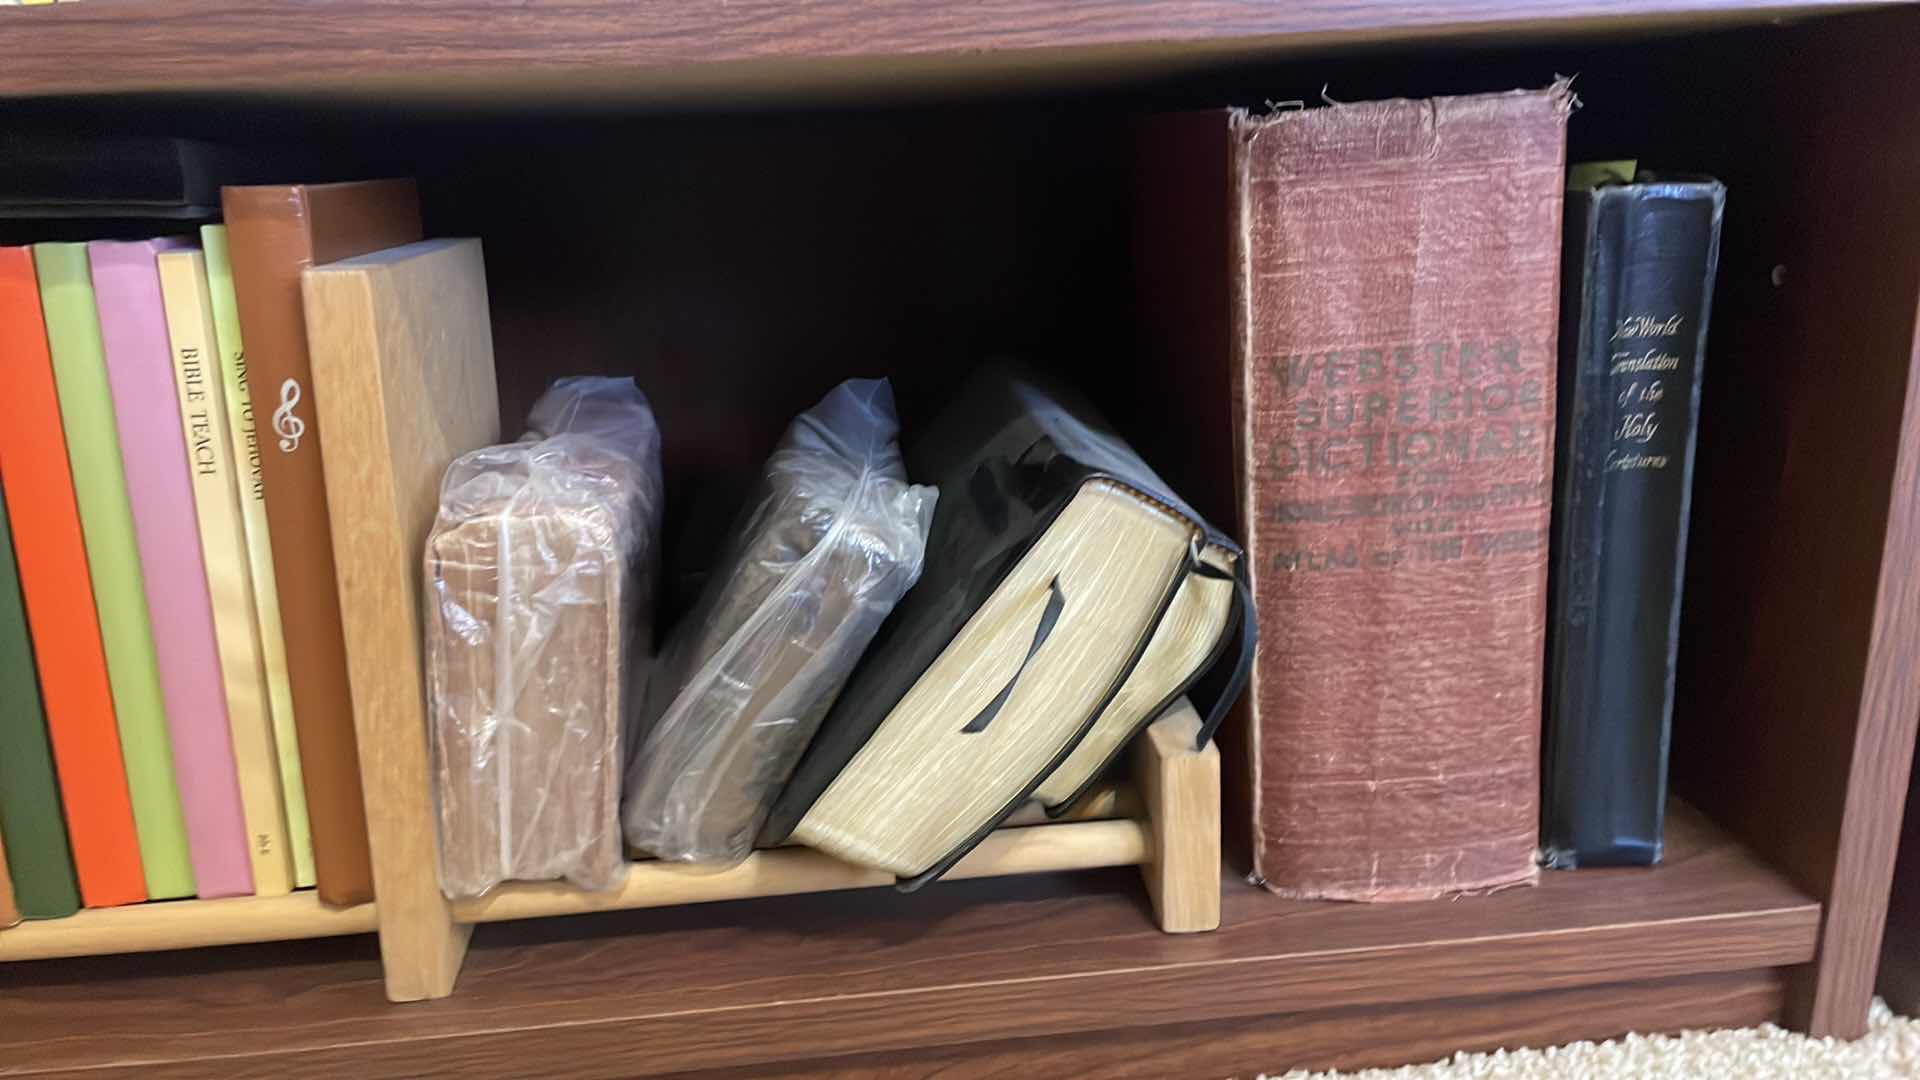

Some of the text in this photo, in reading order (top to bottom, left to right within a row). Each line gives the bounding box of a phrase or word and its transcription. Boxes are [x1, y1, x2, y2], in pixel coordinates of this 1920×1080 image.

[1636, 314, 1684, 337] World
[234, 351, 249, 392] SING
[1269, 340, 1523, 392] WEBSTER
[180, 348, 217, 475] BIBLE TEACH
[1618, 380, 1664, 408] of the
[1615, 412, 1659, 443] Holy
